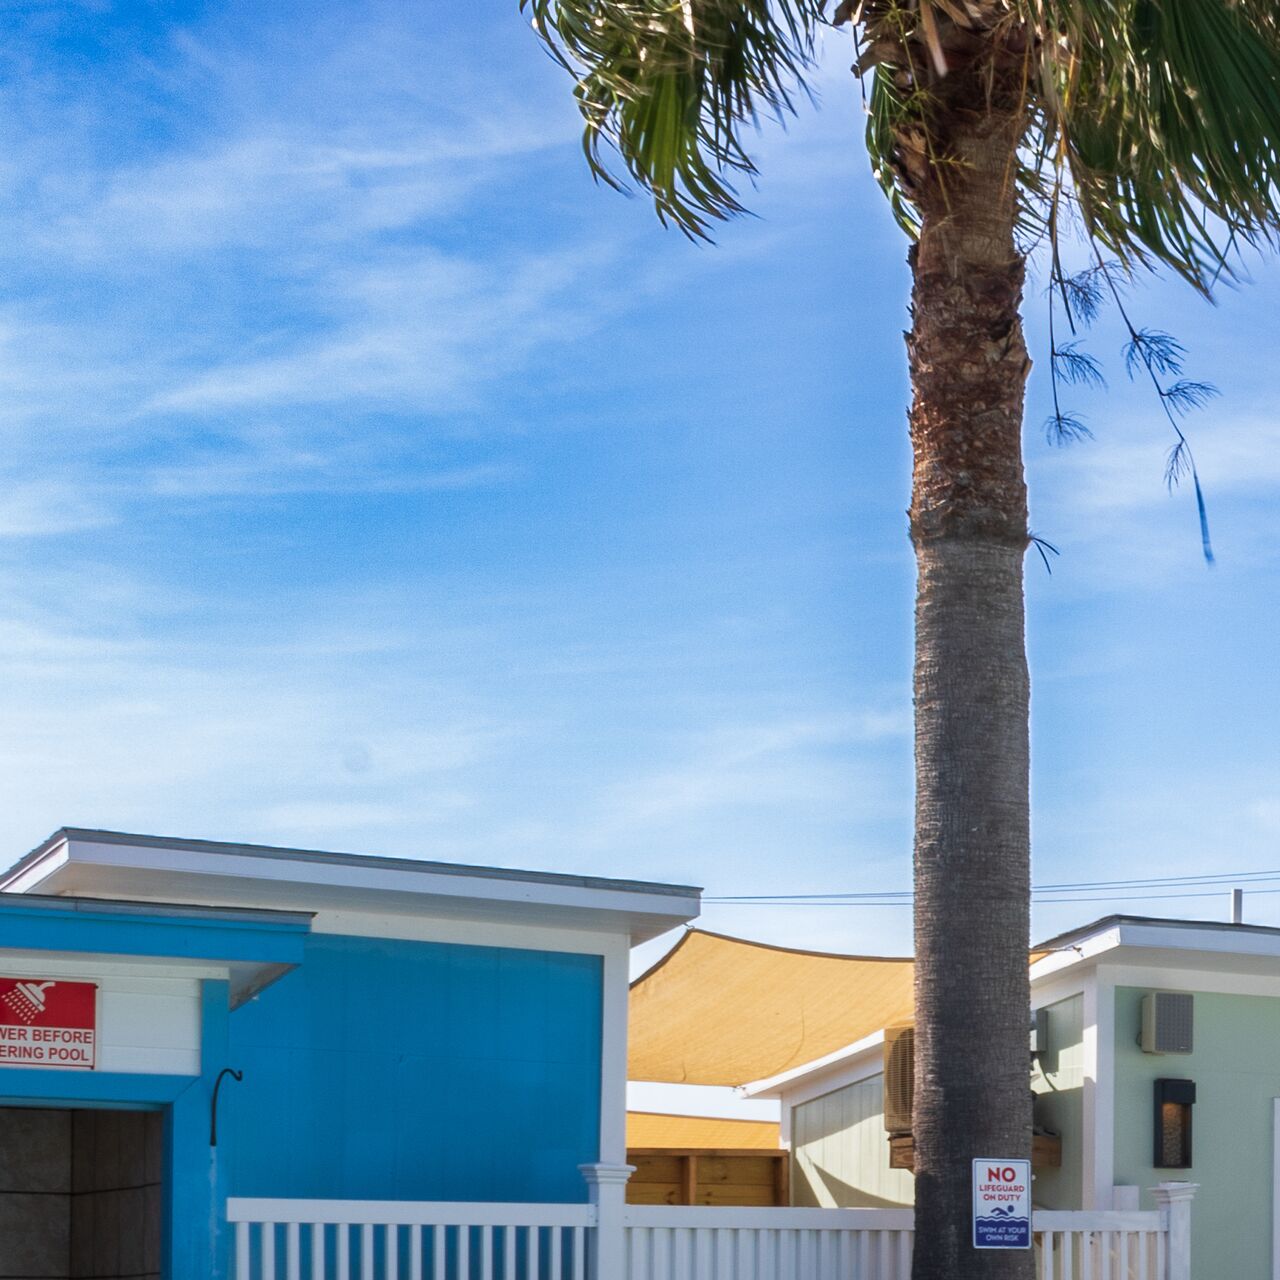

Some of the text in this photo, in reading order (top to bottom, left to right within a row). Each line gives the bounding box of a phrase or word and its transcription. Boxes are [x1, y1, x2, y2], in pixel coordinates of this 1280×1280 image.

[32, 1029, 93, 1044] BEFORE
[0, 1045, 89, 1061] ERING POOL
[988, 1167, 1016, 1182] NO
[979, 1184, 1025, 1192] LIFEGUARD
[983, 1193, 996, 1201] ON
[978, 1226, 1027, 1234] SWIM AT YOUR
